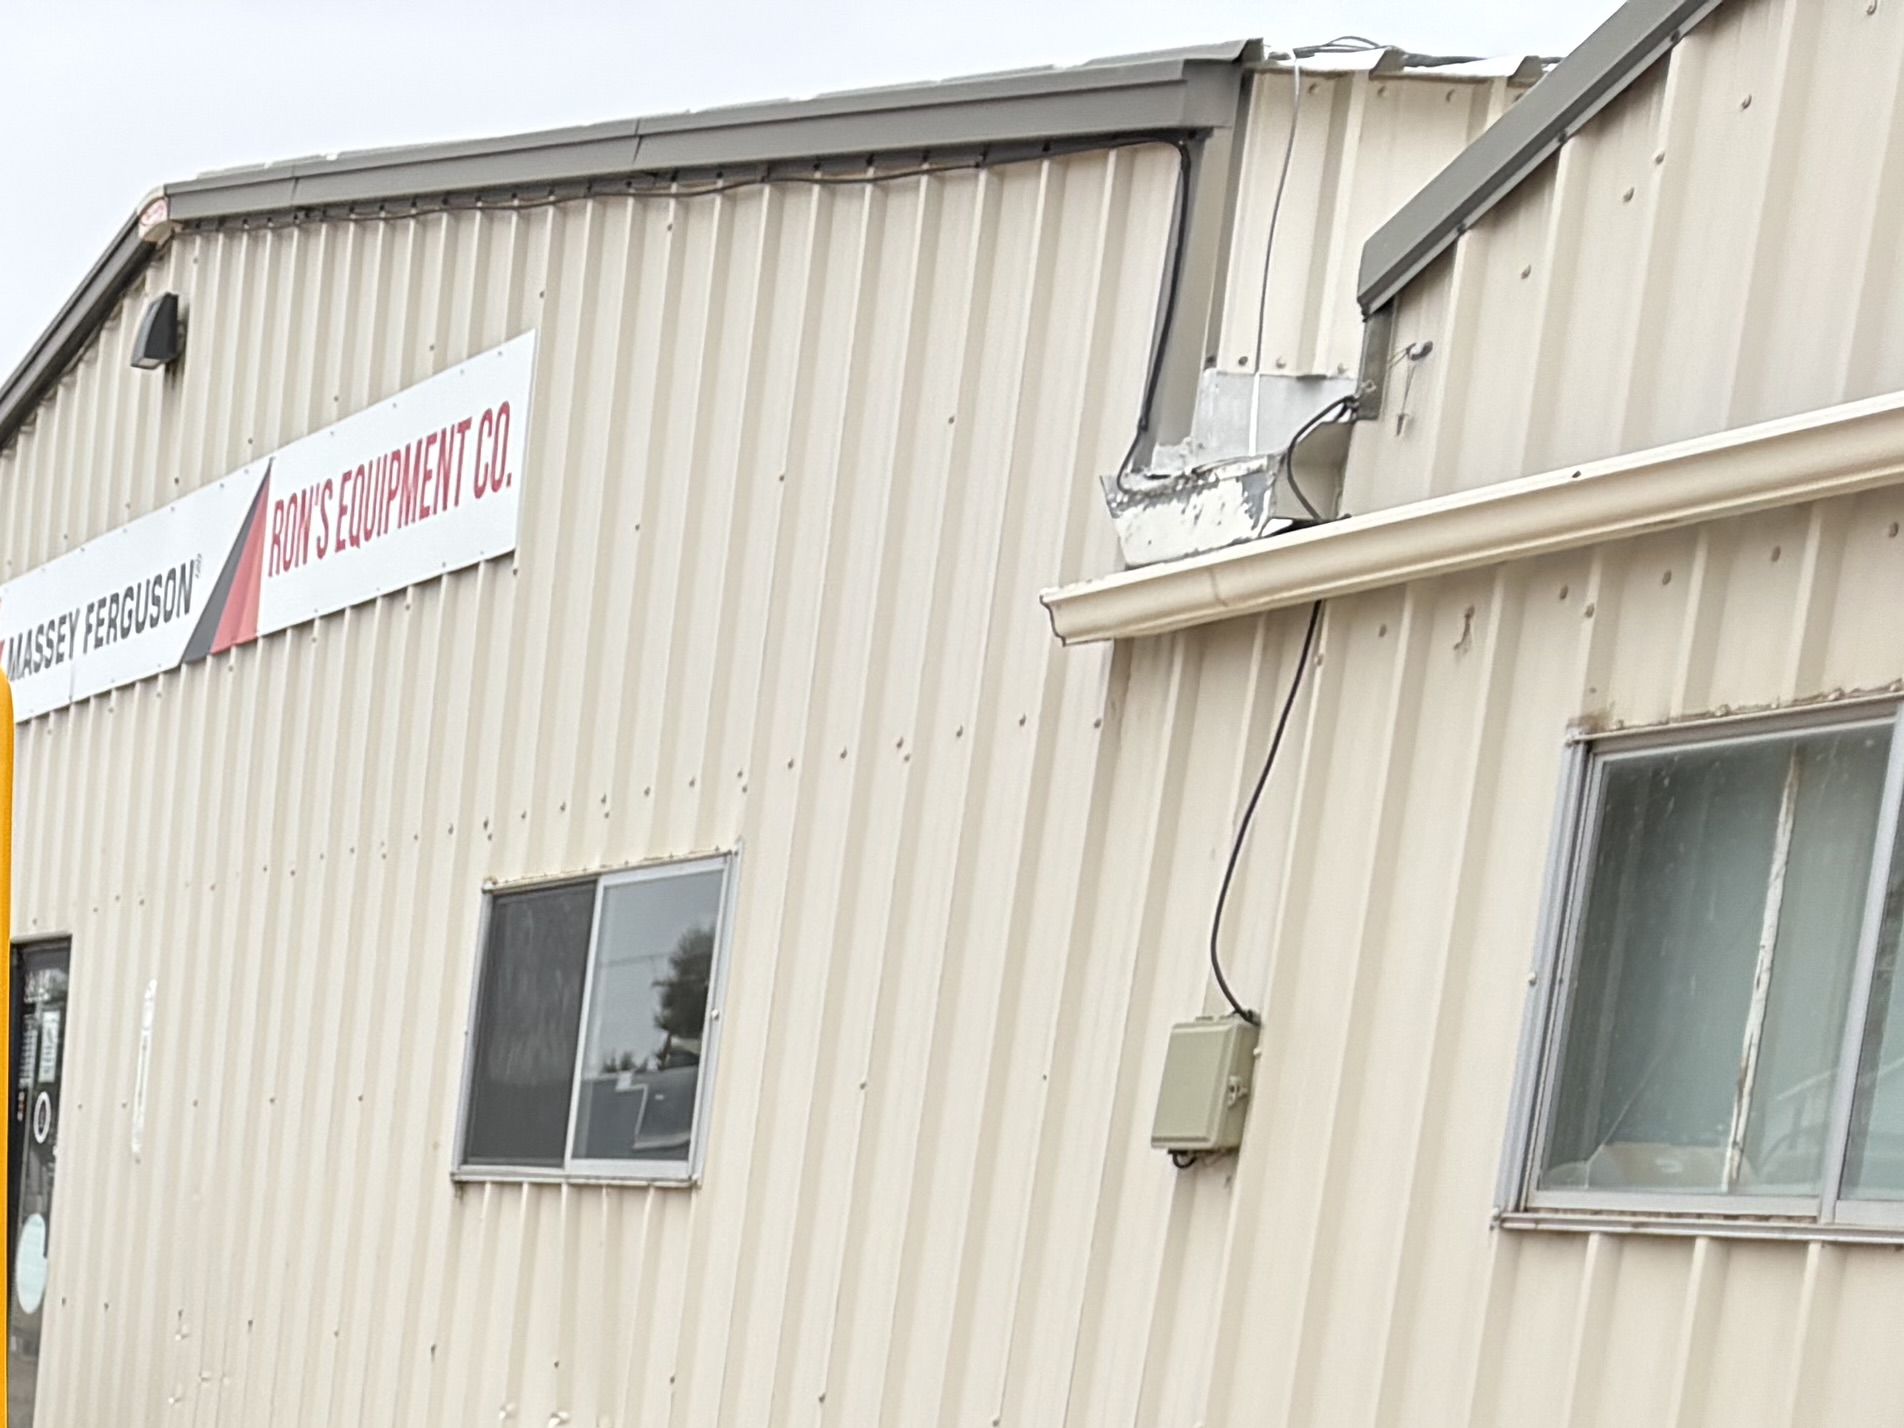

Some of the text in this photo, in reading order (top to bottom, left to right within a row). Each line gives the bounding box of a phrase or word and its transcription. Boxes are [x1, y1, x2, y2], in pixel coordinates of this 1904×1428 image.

[268, 400, 512, 577] RON'S EQUIPMENT CO.
[7, 559, 195, 682] MASSEY FERGUSON
